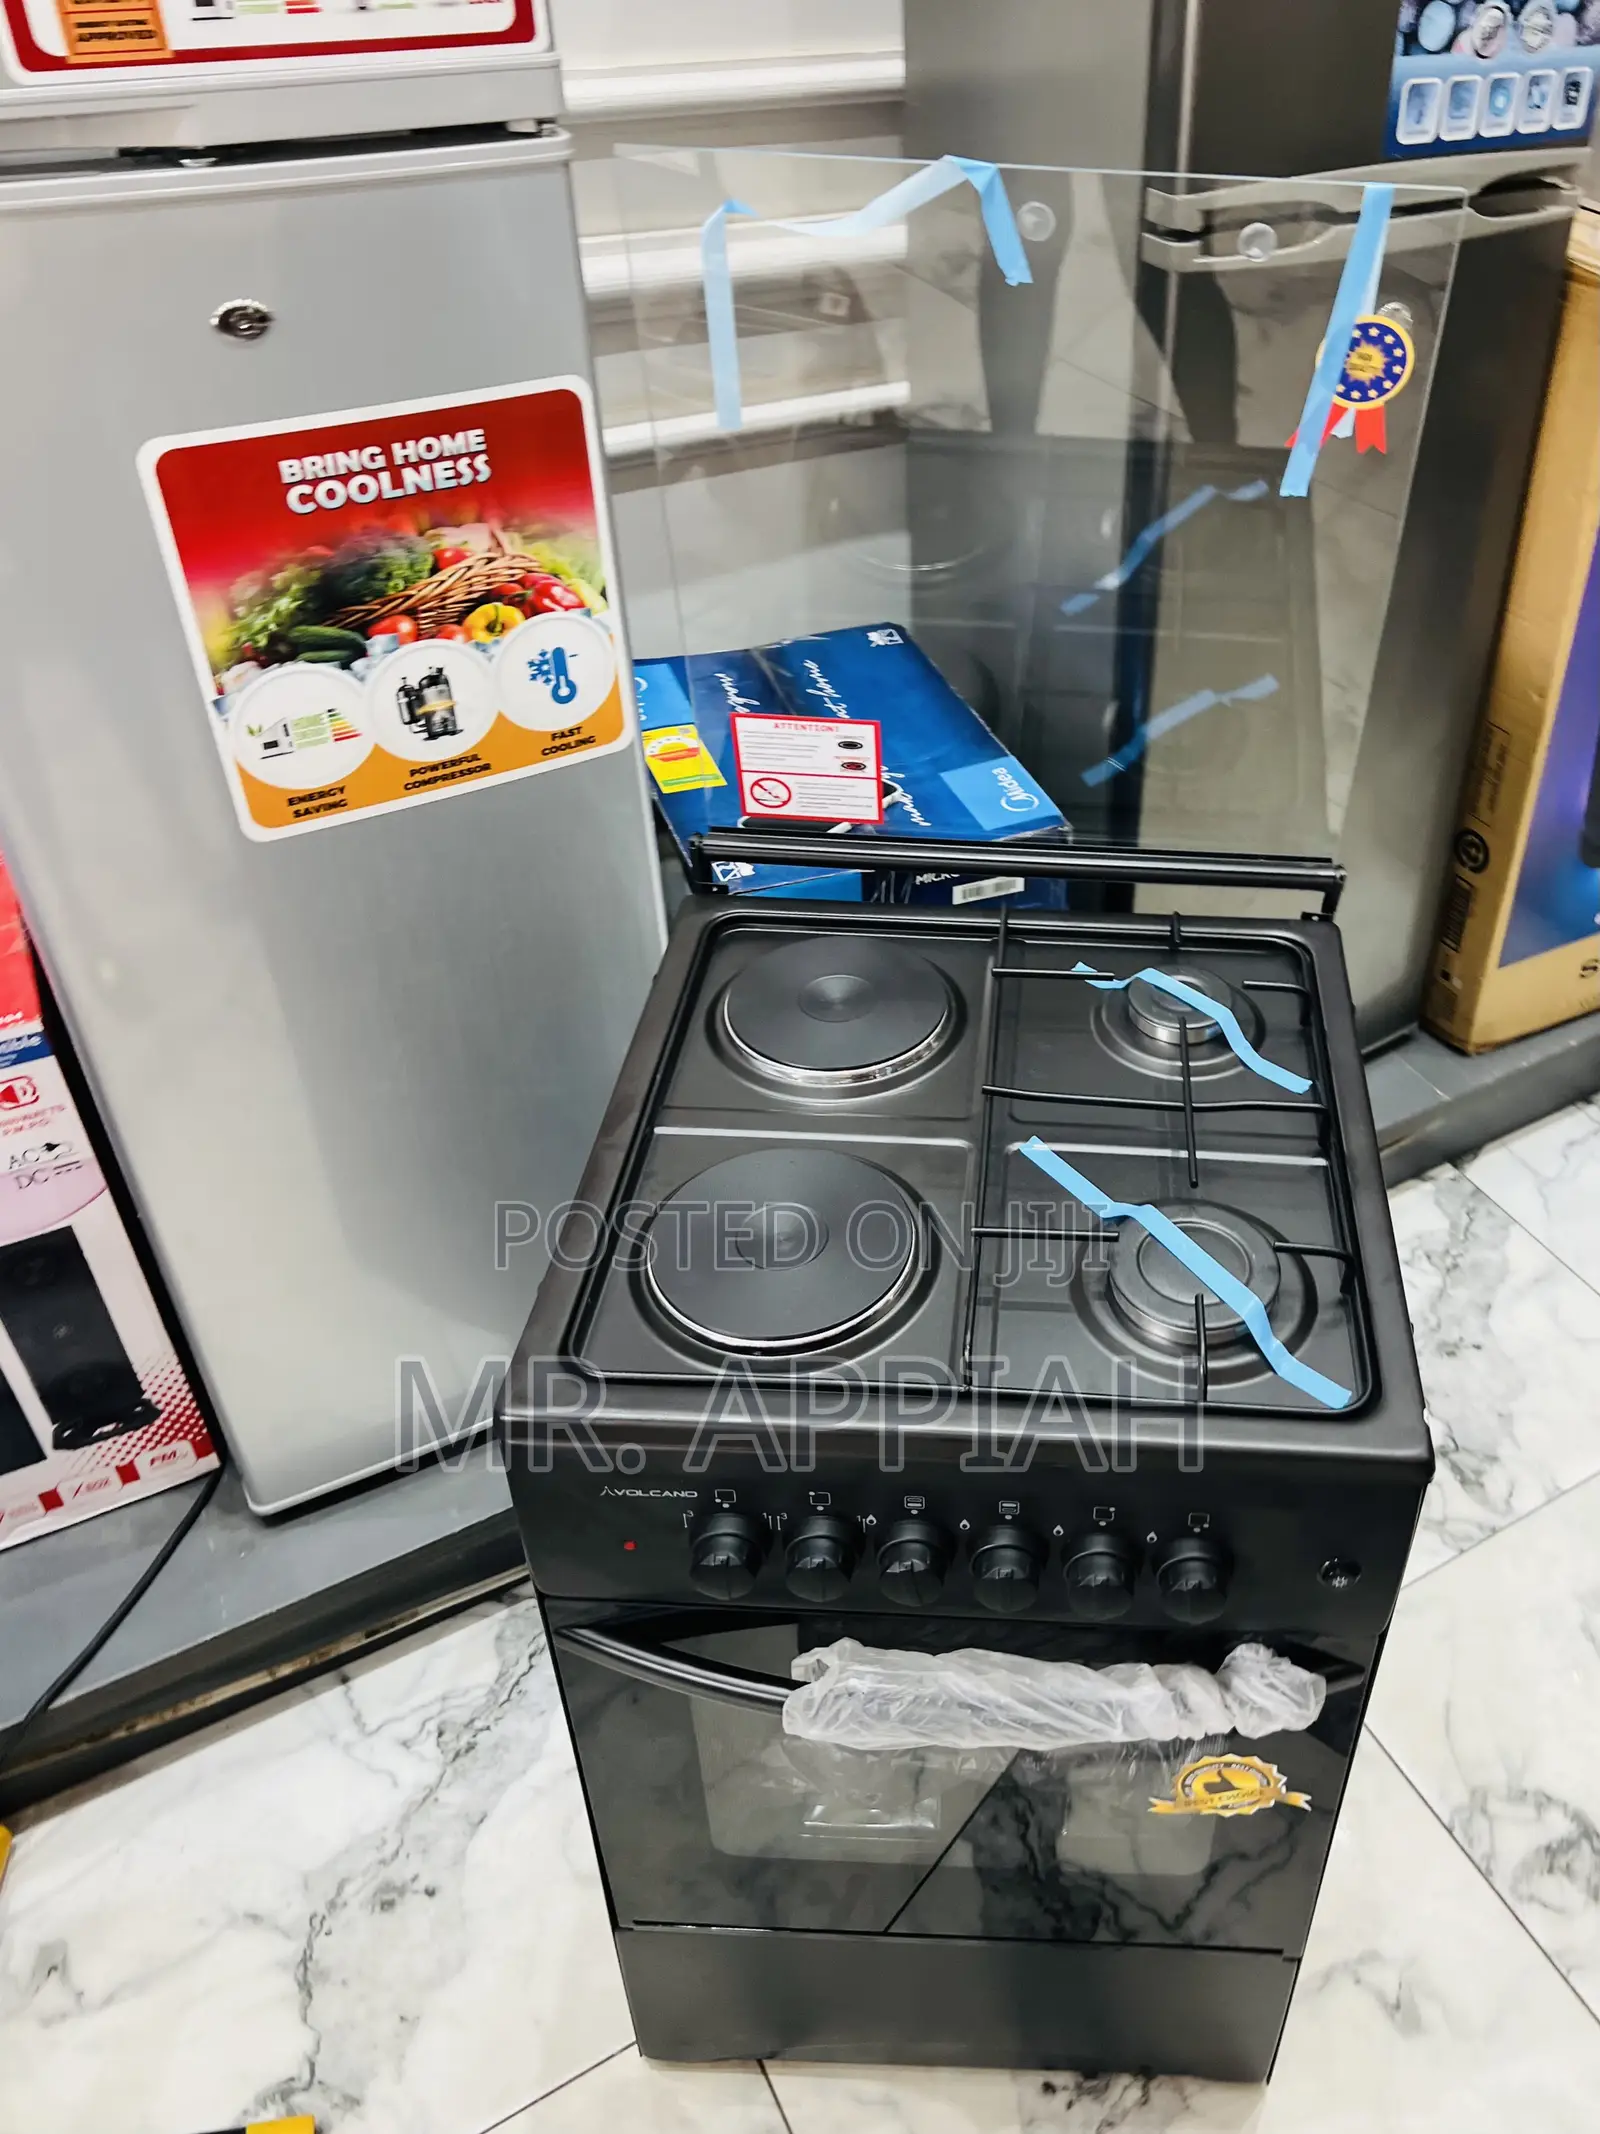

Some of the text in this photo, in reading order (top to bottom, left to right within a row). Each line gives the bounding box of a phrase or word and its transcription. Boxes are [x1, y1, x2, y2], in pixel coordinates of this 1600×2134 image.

[277, 428, 488, 484] BRING HOME
[286, 453, 493, 515] COOLNESS
[551, 726, 583, 742] FAST
[541, 735, 597, 757] COOLING
[403, 762, 492, 791] COMPRESSOR
[409, 752, 483, 778] POWERFUL
[287, 784, 346, 807] ENERGY
[292, 798, 349, 819] SAVING
[612, 1488, 698, 1499] VOLCANO
